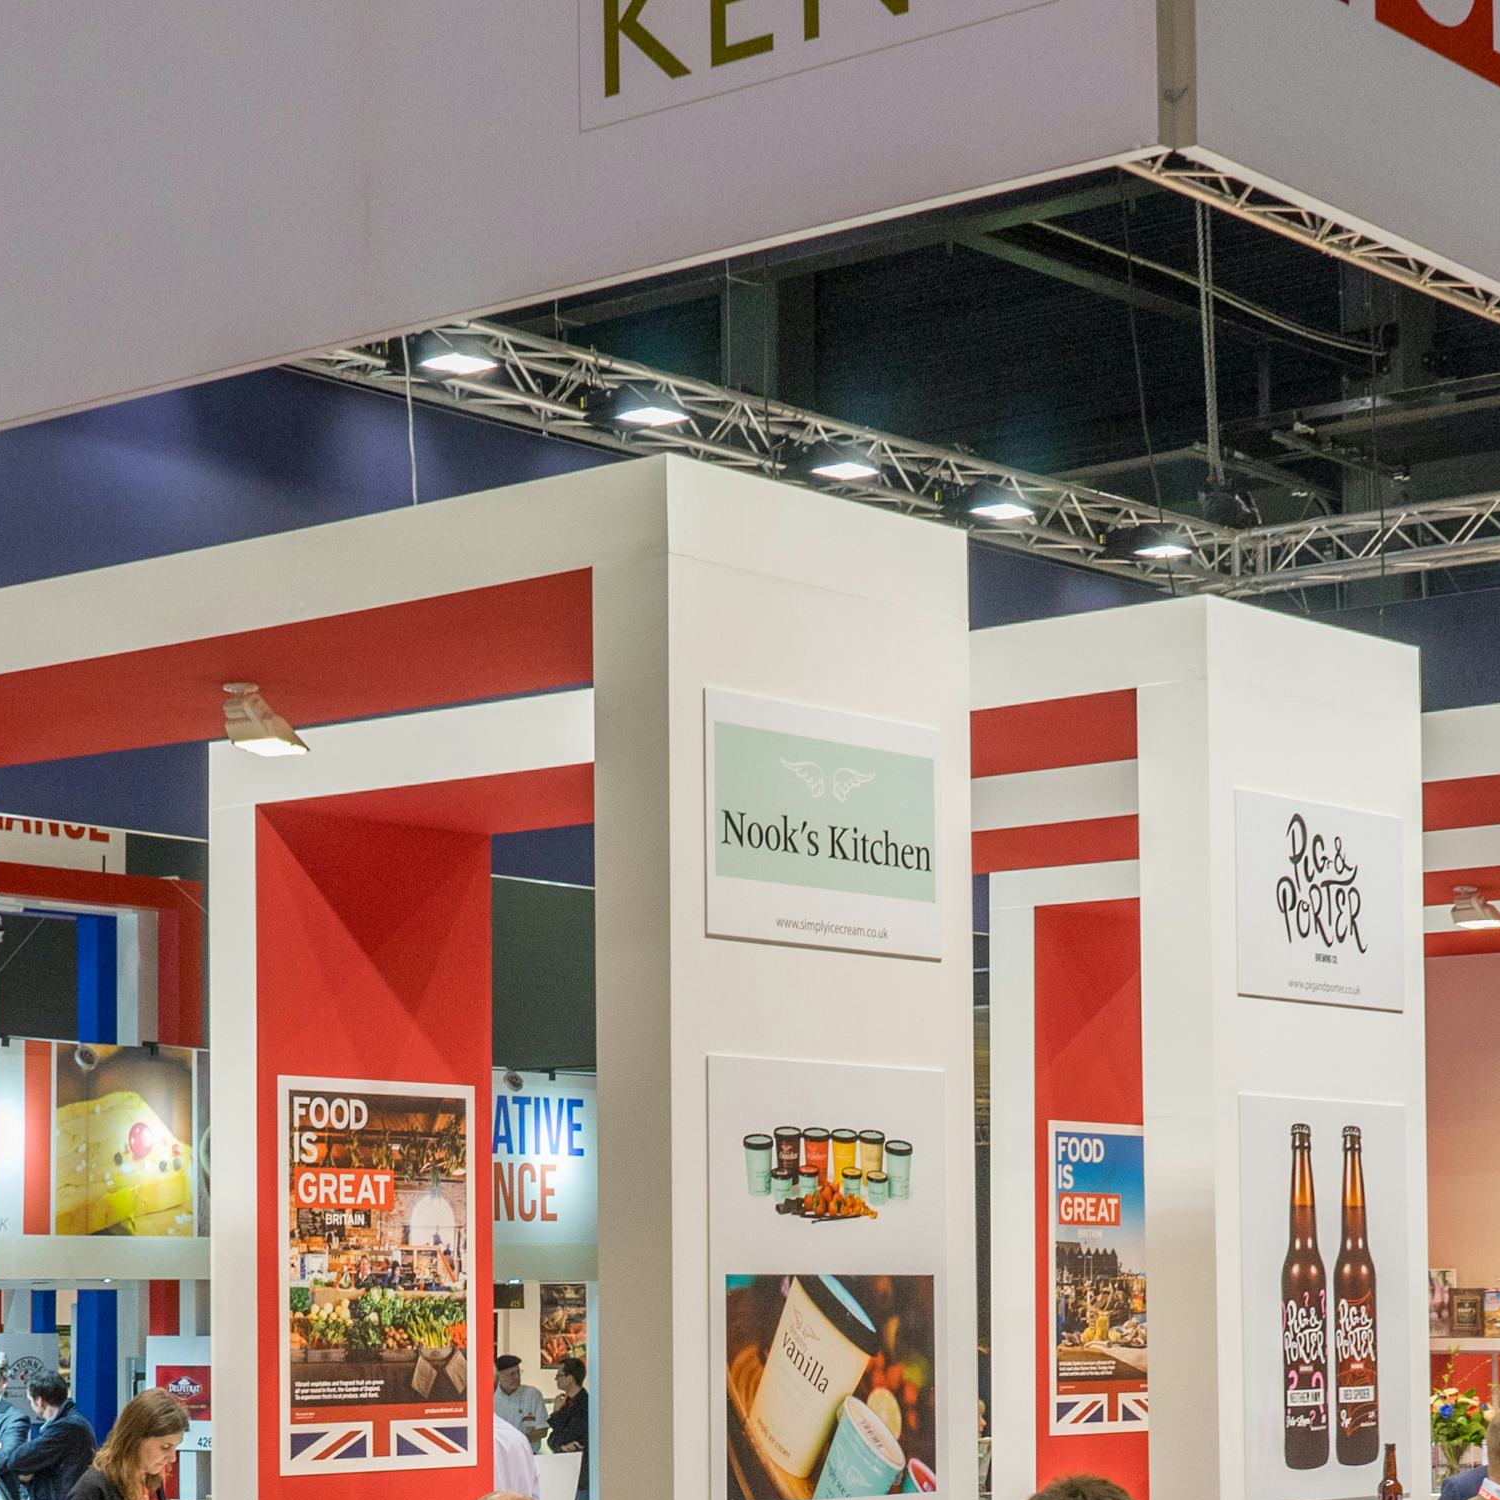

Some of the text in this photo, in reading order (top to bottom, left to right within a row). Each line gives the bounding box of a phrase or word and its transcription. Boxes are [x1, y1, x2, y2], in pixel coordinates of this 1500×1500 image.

[721, 809, 932, 872] Nook's Kitchen
[776, 917, 889, 940] www.simplyicecream.co.uk
[293, 1096, 368, 1130] FOOD
[293, 1131, 318, 1164] IS
[1057, 1137, 1104, 1163] FOOD
[298, 1173, 391, 1205] GREAT
[1058, 1164, 1074, 1190] IS
[325, 1213, 365, 1226] BRITAIN
[1060, 1197, 1119, 1223] GREAT
[782, 1332, 830, 1395] vanilla
